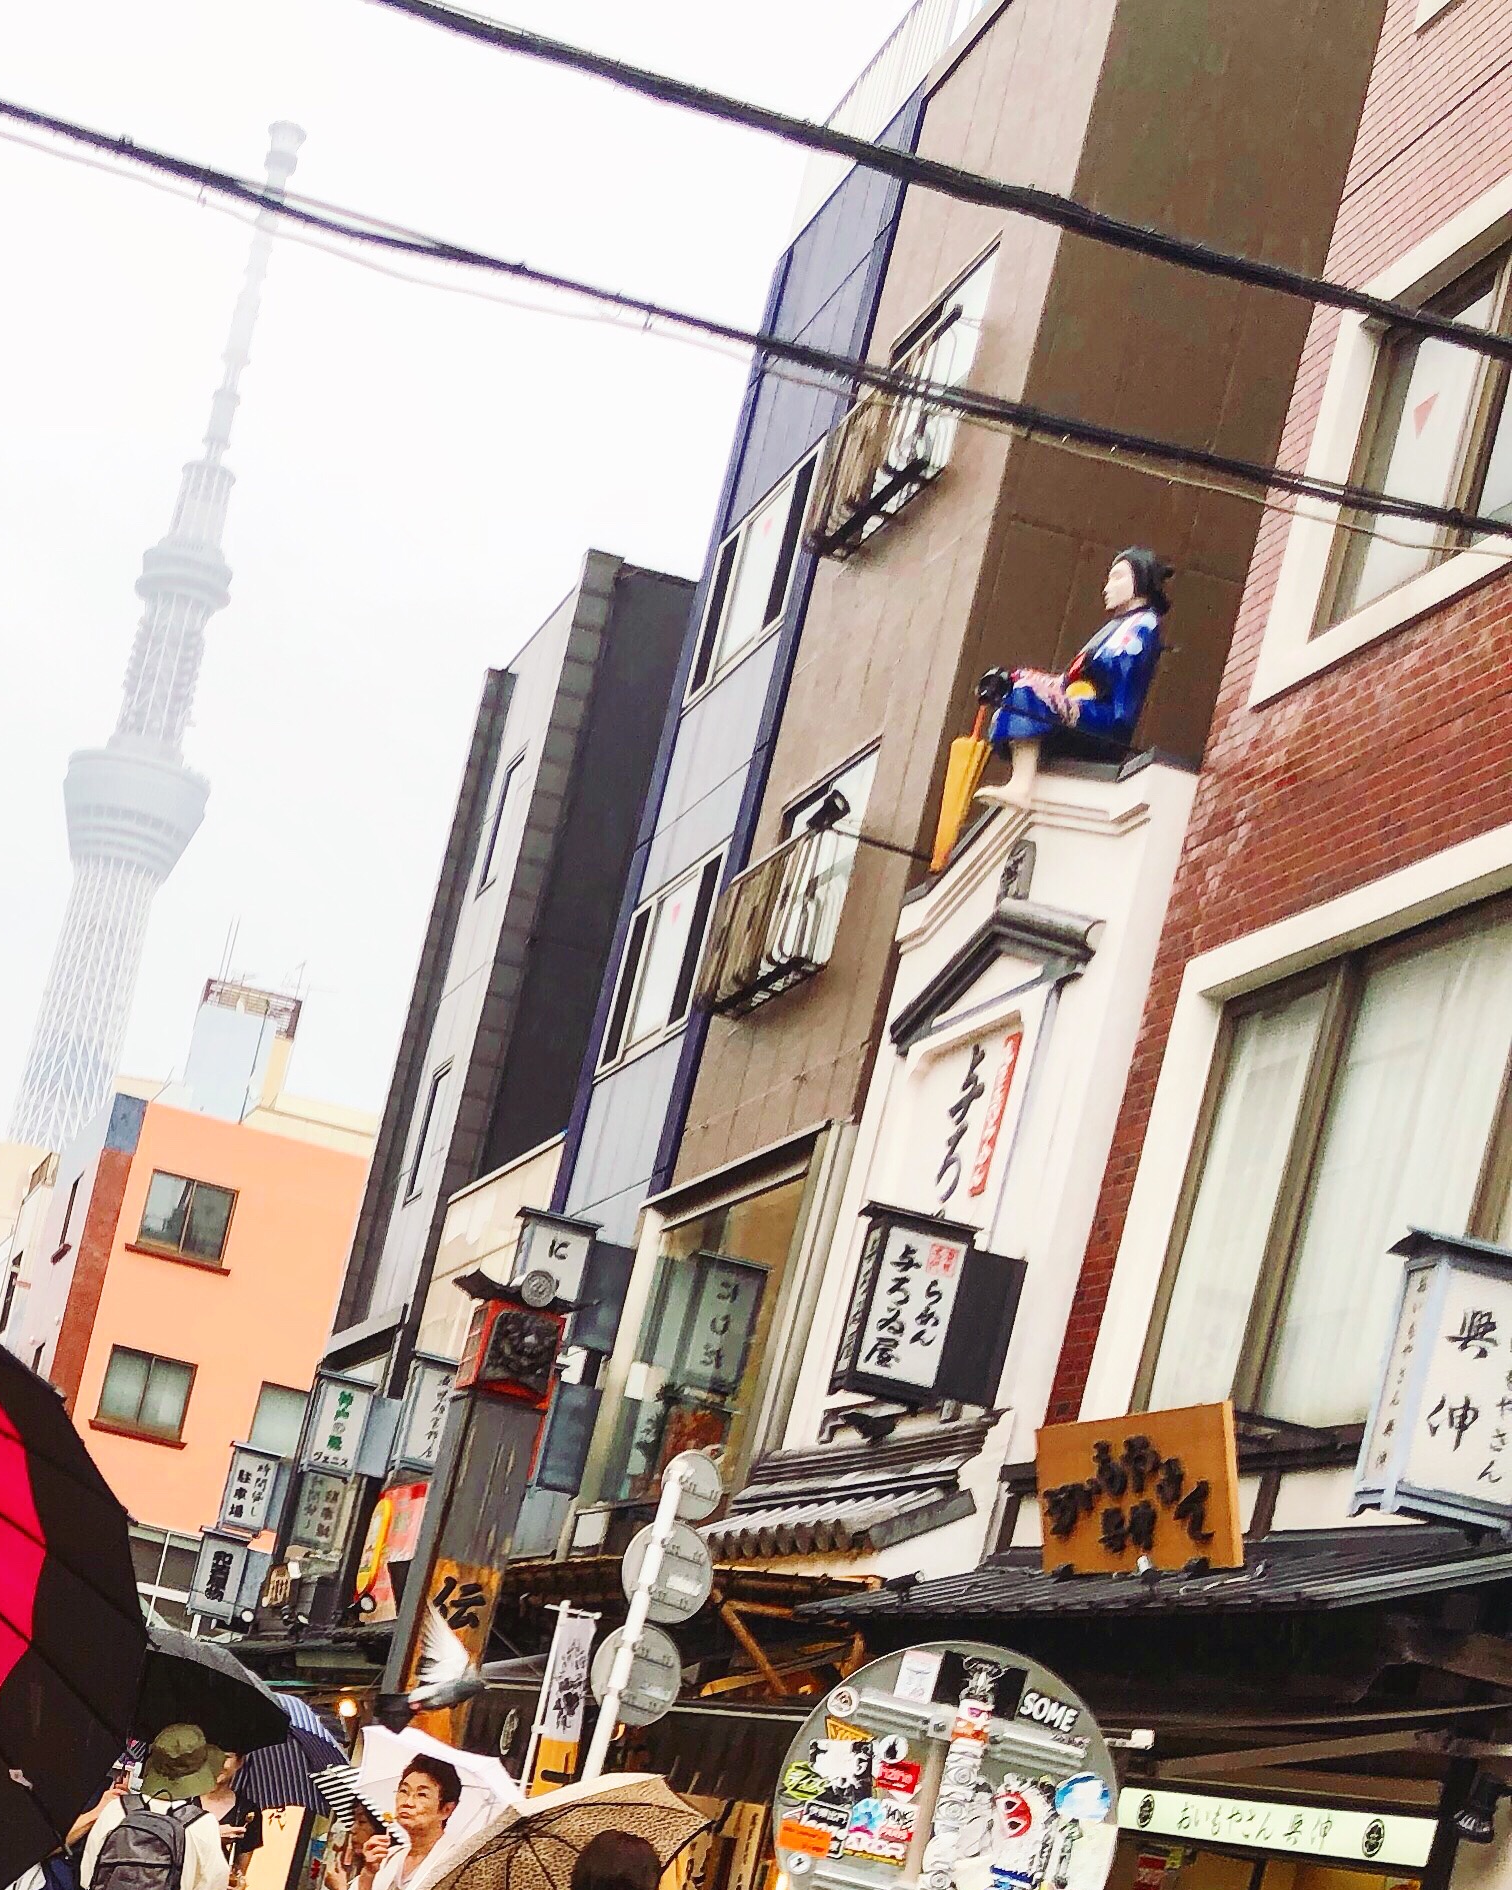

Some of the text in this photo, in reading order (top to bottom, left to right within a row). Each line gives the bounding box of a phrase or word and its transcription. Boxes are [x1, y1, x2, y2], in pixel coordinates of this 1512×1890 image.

[228, 1469, 252, 1518] 駐車場
[433, 1576, 486, 1630] 伝
[1019, 1692, 1078, 1734] SOME
